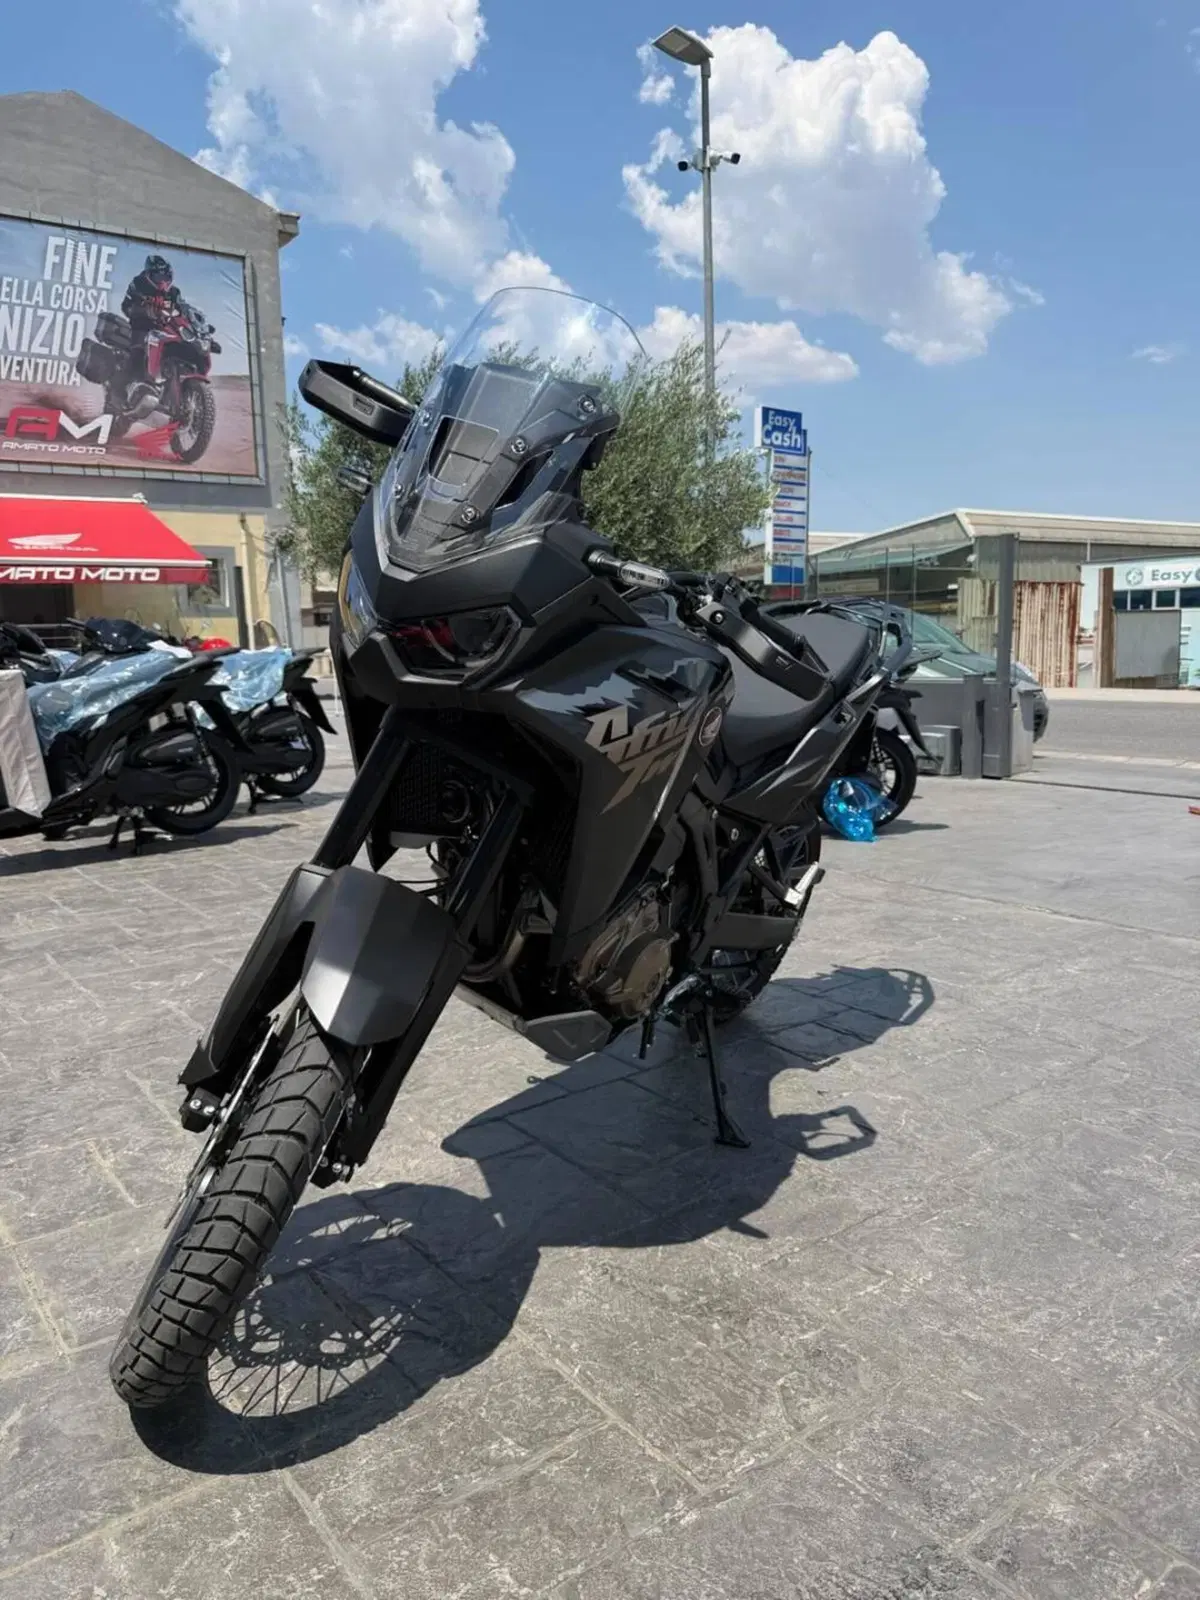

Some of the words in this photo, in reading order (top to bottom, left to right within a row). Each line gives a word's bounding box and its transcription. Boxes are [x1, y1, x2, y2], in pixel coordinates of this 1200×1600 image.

[43, 235, 117, 289] FINE
[2, 276, 43, 307] ELLA
[50, 284, 107, 314] CORSA
[0, 304, 85, 359] NIZIO
[4, 406, 114, 445] AM
[768, 410, 796, 432] Easy
[2, 441, 60, 453] AMATO
[62, 444, 106, 455] MOTO
[762, 424, 802, 449] Cash
[80, 567, 161, 582] MOTO
[1151, 568, 1193, 584] Easy
